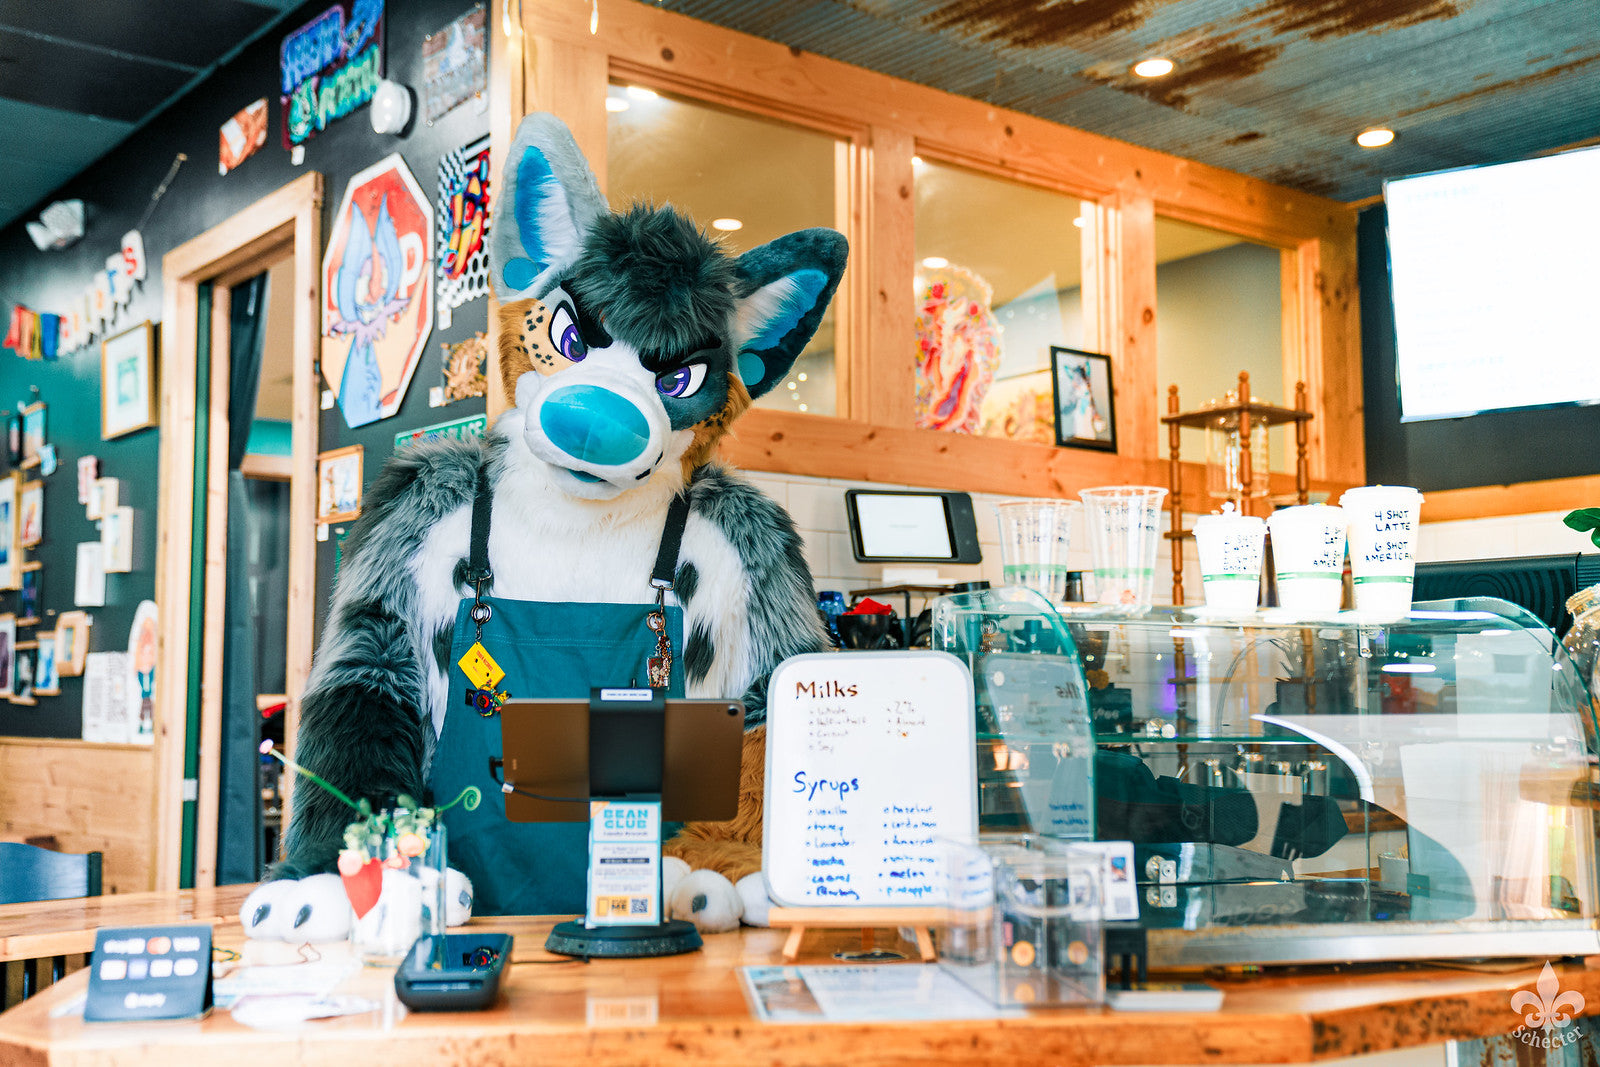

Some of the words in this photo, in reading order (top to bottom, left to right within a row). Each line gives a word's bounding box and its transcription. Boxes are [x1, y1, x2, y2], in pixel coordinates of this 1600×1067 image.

[1374, 510, 1382, 521] 4
[1386, 509, 1409, 520] SHOT
[1375, 521, 1411, 532] LATTE
[1374, 541, 1382, 552] 6
[1386, 541, 1408, 551] SHOT
[796, 680, 858, 700] Milks
[793, 771, 859, 801] Syrups
[603, 809, 649, 819] BEAN
[604, 820, 648, 829] CLUB
